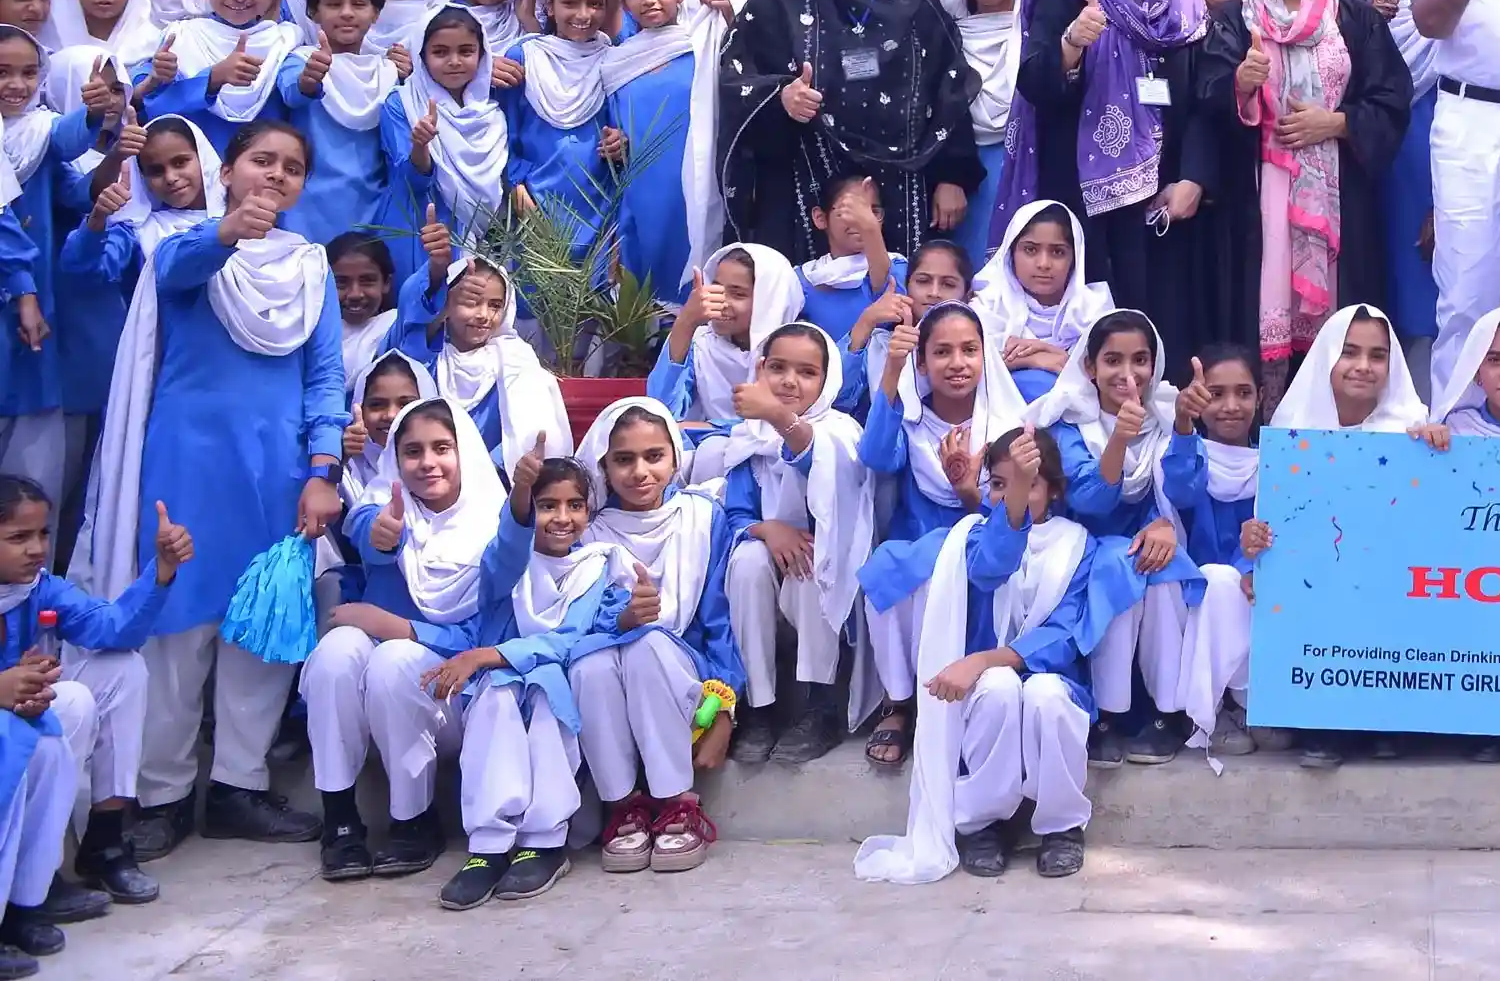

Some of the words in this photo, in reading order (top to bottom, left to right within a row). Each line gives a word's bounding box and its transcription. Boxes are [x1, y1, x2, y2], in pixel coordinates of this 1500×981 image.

[1302, 644, 1328, 657] For
[1331, 645, 1401, 664] Providing
[1405, 648, 1446, 663] Clean
[1291, 666, 1315, 690] By
[1320, 668, 1456, 691] GOVERNMENT
